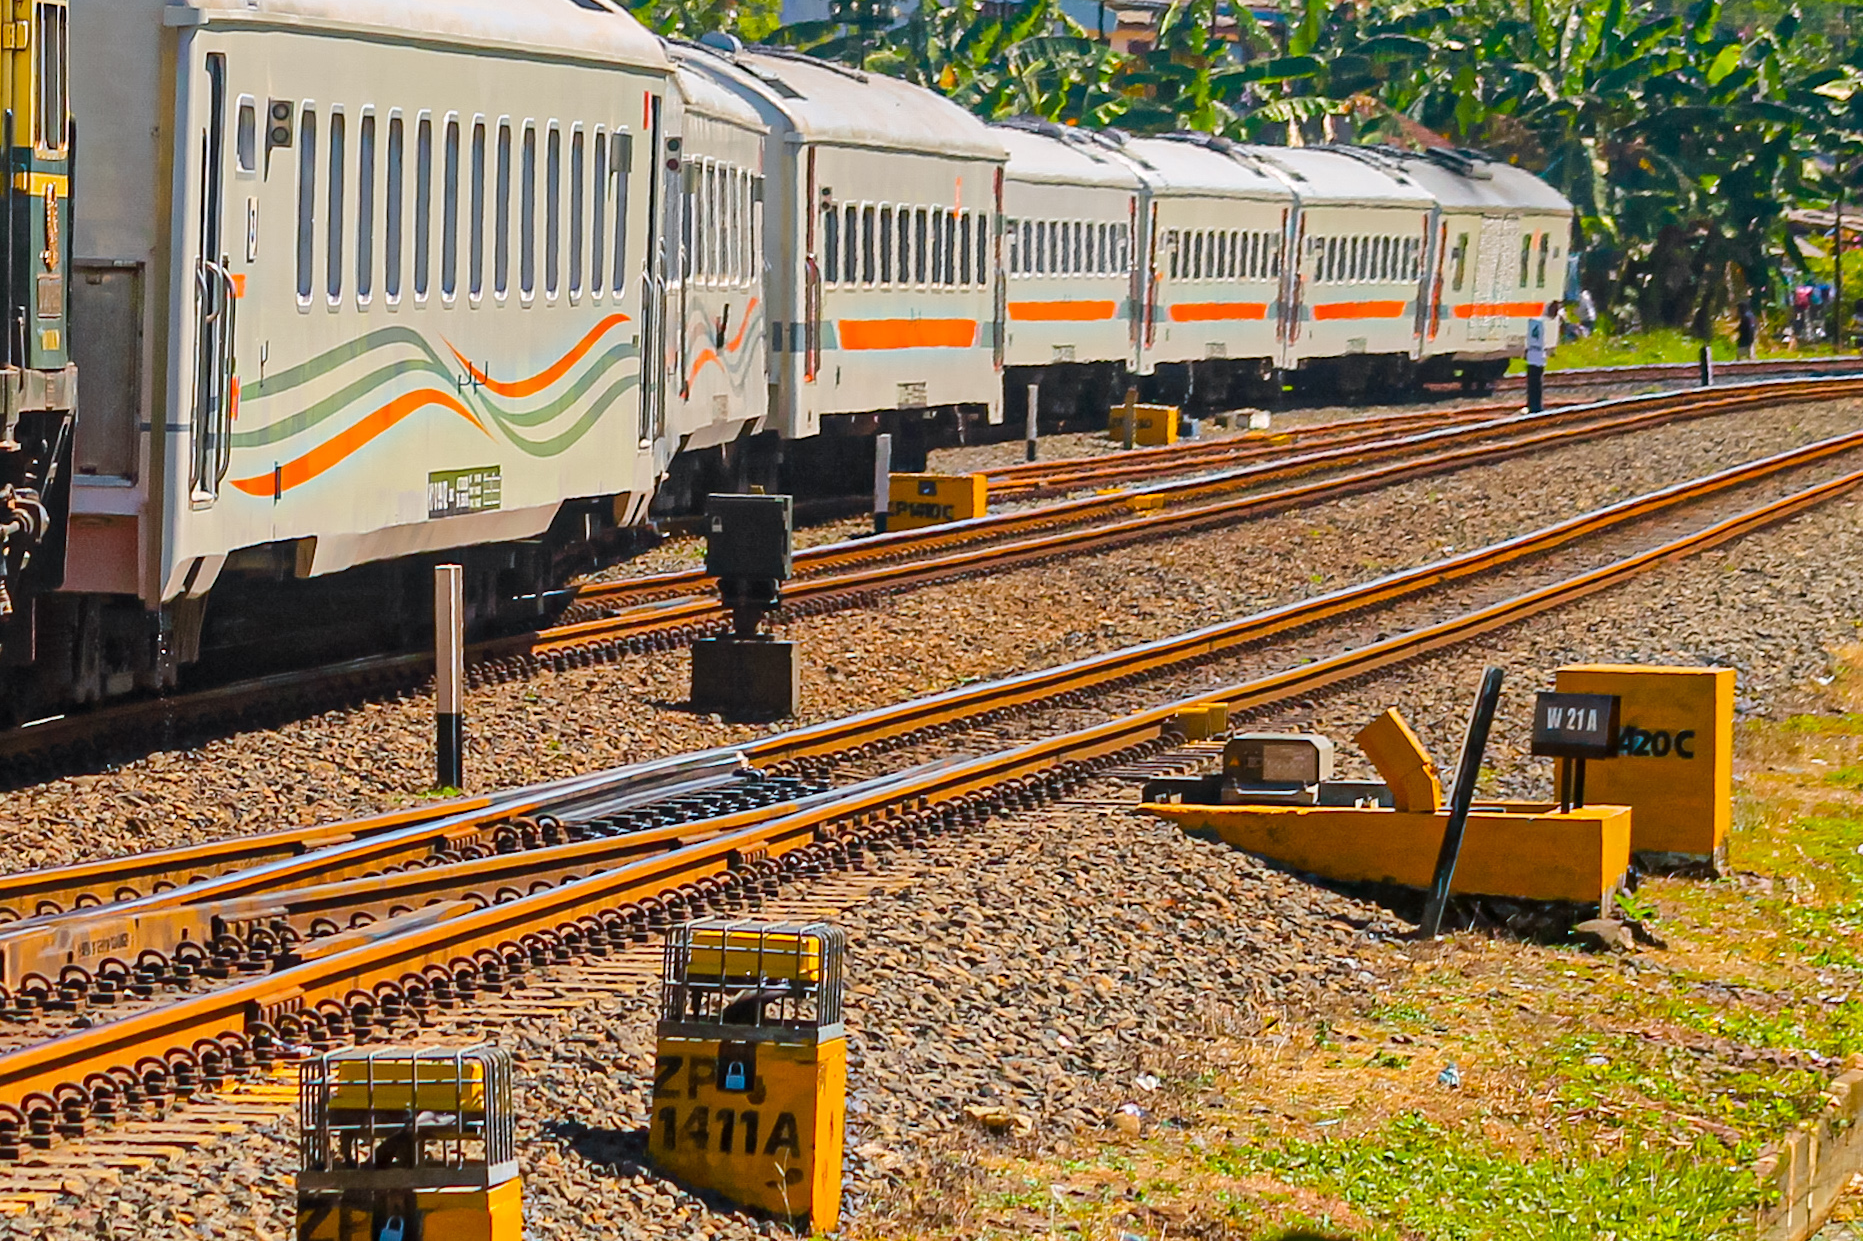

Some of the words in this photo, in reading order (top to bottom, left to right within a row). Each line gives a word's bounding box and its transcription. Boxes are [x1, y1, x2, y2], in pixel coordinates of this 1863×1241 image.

[1547, 707, 1563, 729] W
[653, 1055, 718, 1099] ZP
[658, 1106, 800, 1158] 1411A
